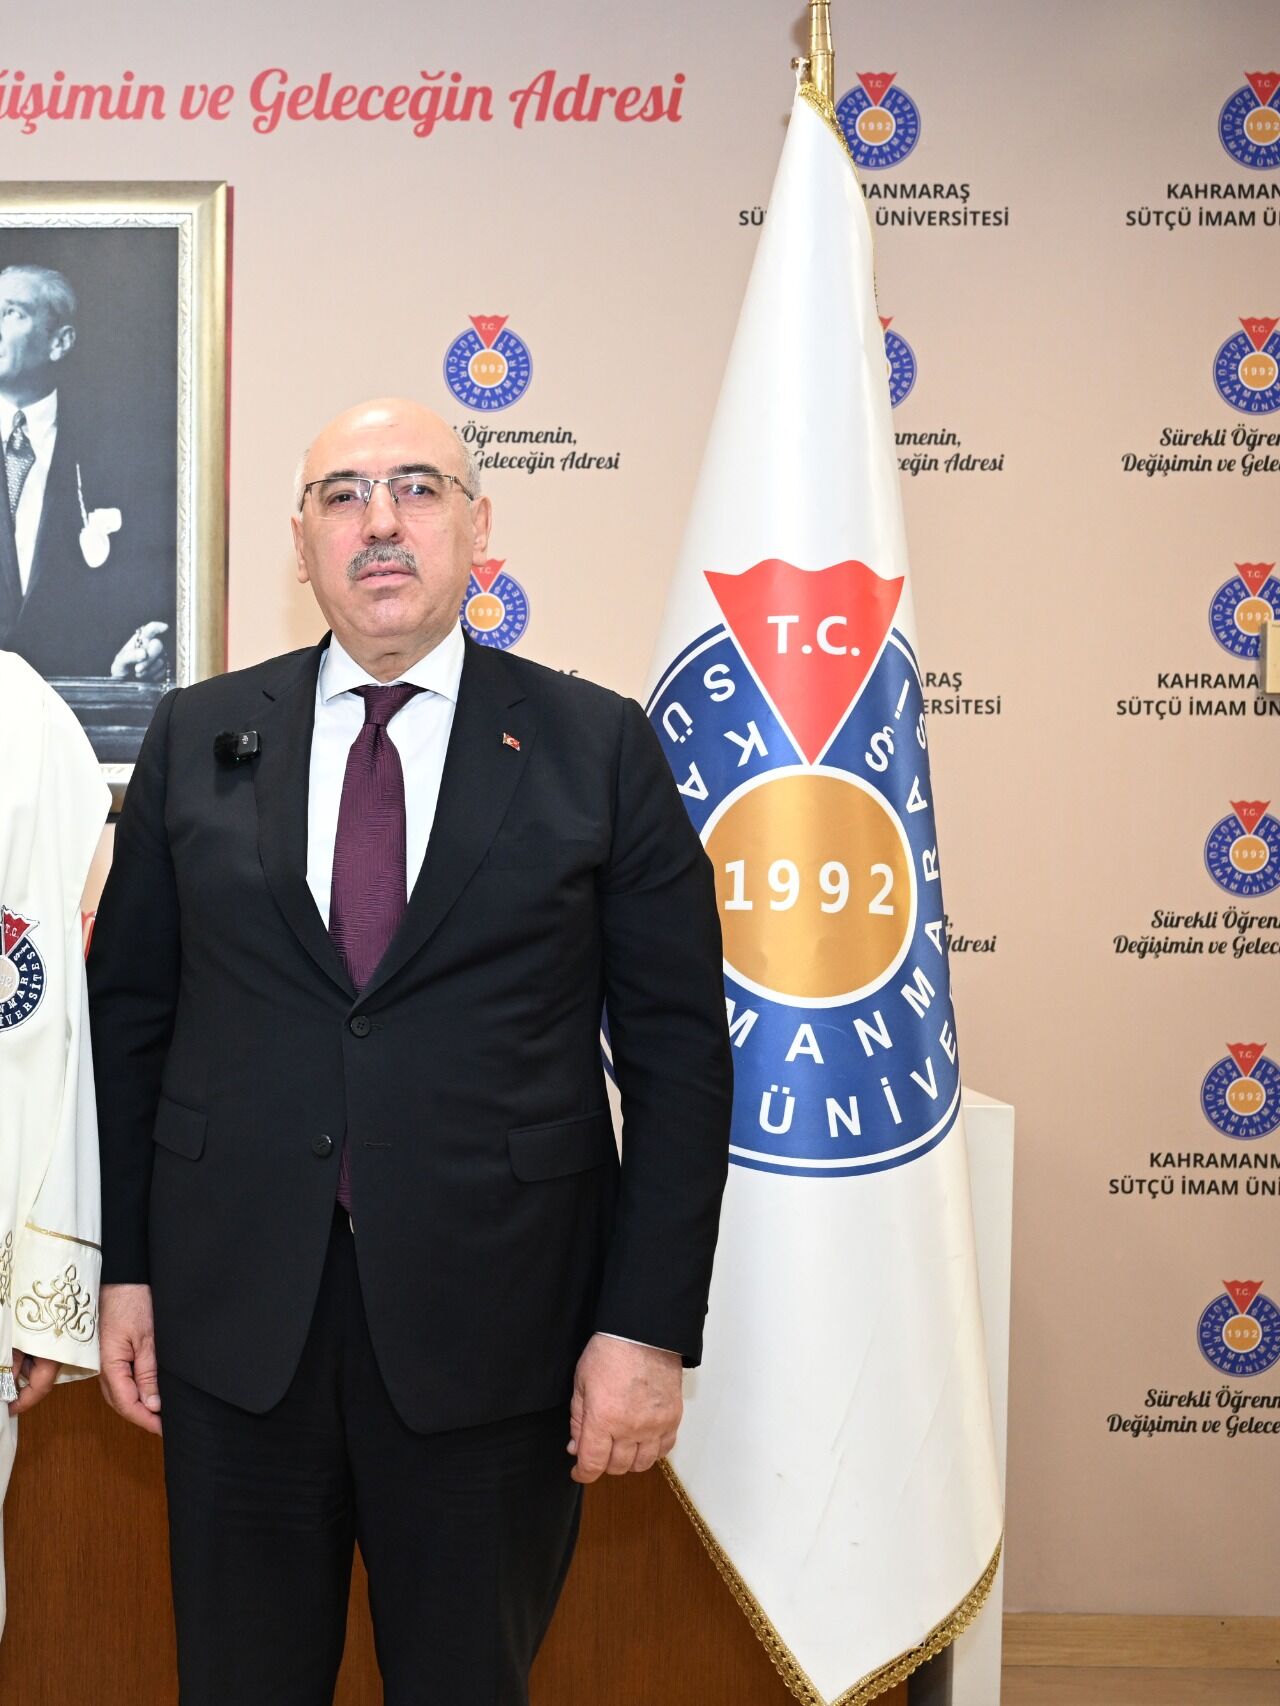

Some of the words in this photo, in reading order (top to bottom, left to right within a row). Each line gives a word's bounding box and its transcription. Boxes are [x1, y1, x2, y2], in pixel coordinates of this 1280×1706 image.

[179, 82, 234, 121] ve
[249, 68, 494, 138] Geleceğin
[508, 69, 686, 129] Adresi
[861, 122, 891, 131] 1992
[1167, 184, 1280, 199] KAHRAMAN
[875, 207, 1009, 227] ÜNİVERSİTESİ
[1126, 207, 1191, 230] SÜTÇÜ
[1199, 207, 1255, 226] İMAM
[474, 365, 504, 374] 1992
[1244, 368, 1274, 377] 1992
[461, 421, 577, 449] Öğrenmenin,
[1160, 428, 1227, 447] Sürekli
[560, 450, 620, 471] Adresi
[944, 453, 1005, 472] Adresi
[1122, 453, 1212, 477] Değişimin
[1217, 459, 1236, 472] ve
[470, 608, 500, 617] 1992
[1239, 612, 1269, 621] 1992
[767, 615, 860, 657] T.C.
[1157, 673, 1259, 689] KAHRAMA
[923, 696, 1001, 715] ERSİTESİ
[1117, 696, 1182, 720] SÜTÇÜ
[1189, 696, 1246, 717] İMAM
[1235, 850, 1264, 859] 1992
[724, 859, 894, 915] 1992
[1151, 910, 1218, 929] Sürekli
[5, 923, 19, 938] T.C.
[1113, 935, 1204, 959] Değişimin
[1208, 941, 1227, 954] ve
[1232, 936, 1280, 959] Gelec
[1231, 1092, 1261, 1101] 1992
[1150, 1152, 1280, 1169] KAHRAMAN
[1109, 1175, 1174, 1199] SÜTÇÜ
[1181, 1175, 1239, 1195] İMAM
[1228, 1329, 1257, 1338] 1992
[1145, 1389, 1211, 1408] Sürekli
[1107, 1414, 1197, 1438] Değişimin
[1202, 1420, 1221, 1433] ve
[1226, 1415, 1280, 1438] Gelece
